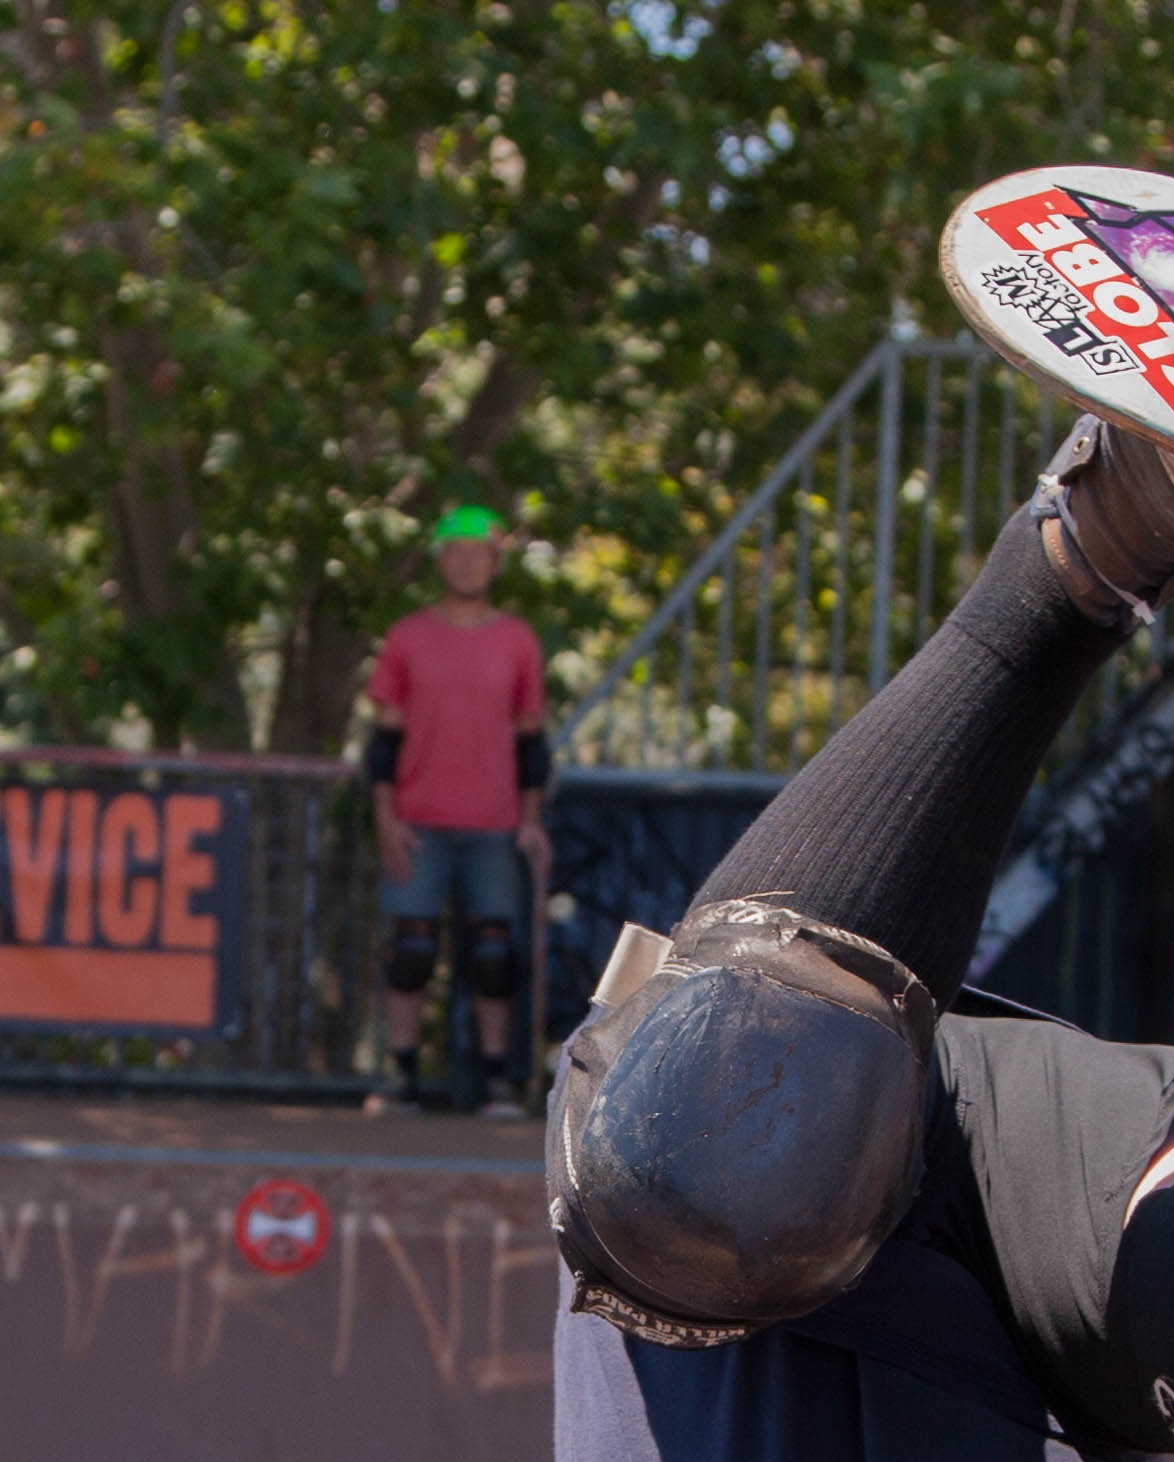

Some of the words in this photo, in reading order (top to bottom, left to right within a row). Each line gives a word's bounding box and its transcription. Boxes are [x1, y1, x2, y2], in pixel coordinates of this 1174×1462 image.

[985, 266, 1138, 374] SLAM
[1018, 253, 1088, 314] factory
[0, 788, 222, 948] VICE
